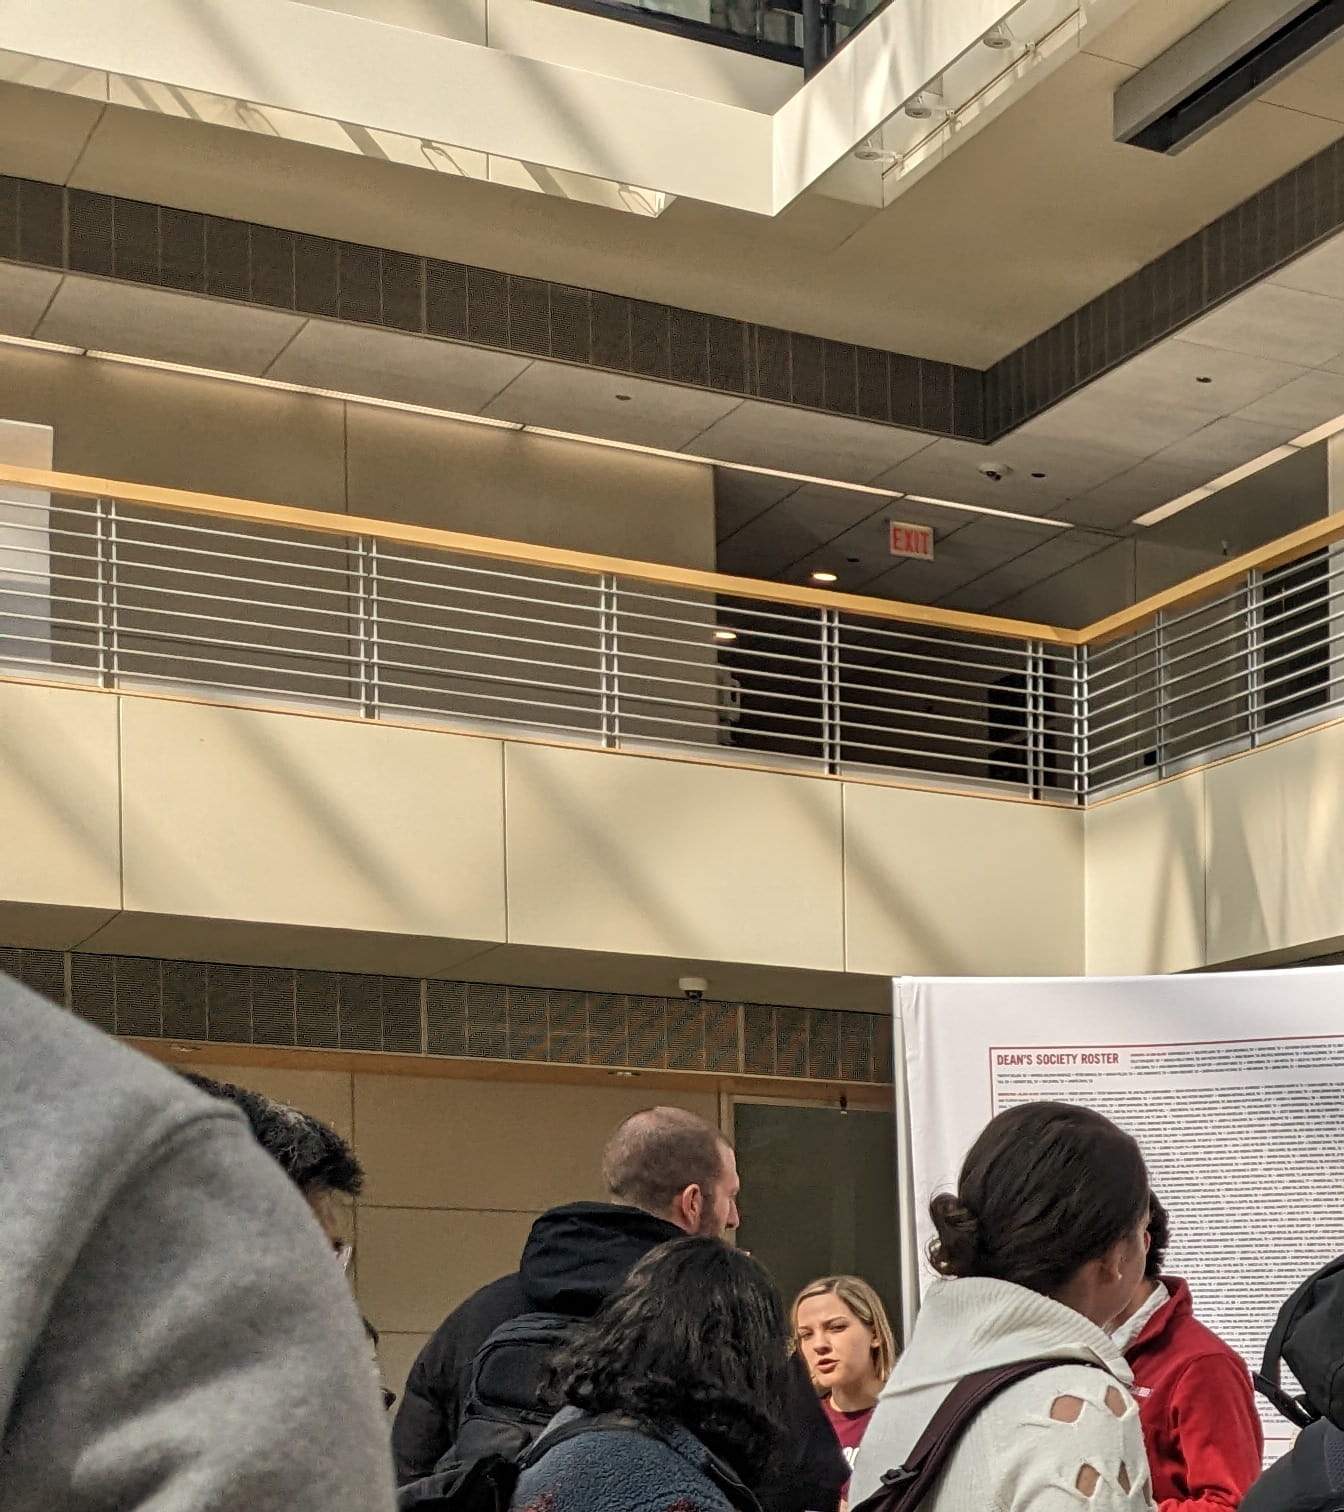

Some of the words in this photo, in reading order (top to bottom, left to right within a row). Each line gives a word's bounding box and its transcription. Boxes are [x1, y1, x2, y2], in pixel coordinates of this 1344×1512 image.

[893, 527, 930, 555] EXIT
[996, 1053, 1033, 1066] DEAN'S
[1036, 1053, 1079, 1065] SOCIETY
[1081, 1052, 1120, 1065] ROSTER
